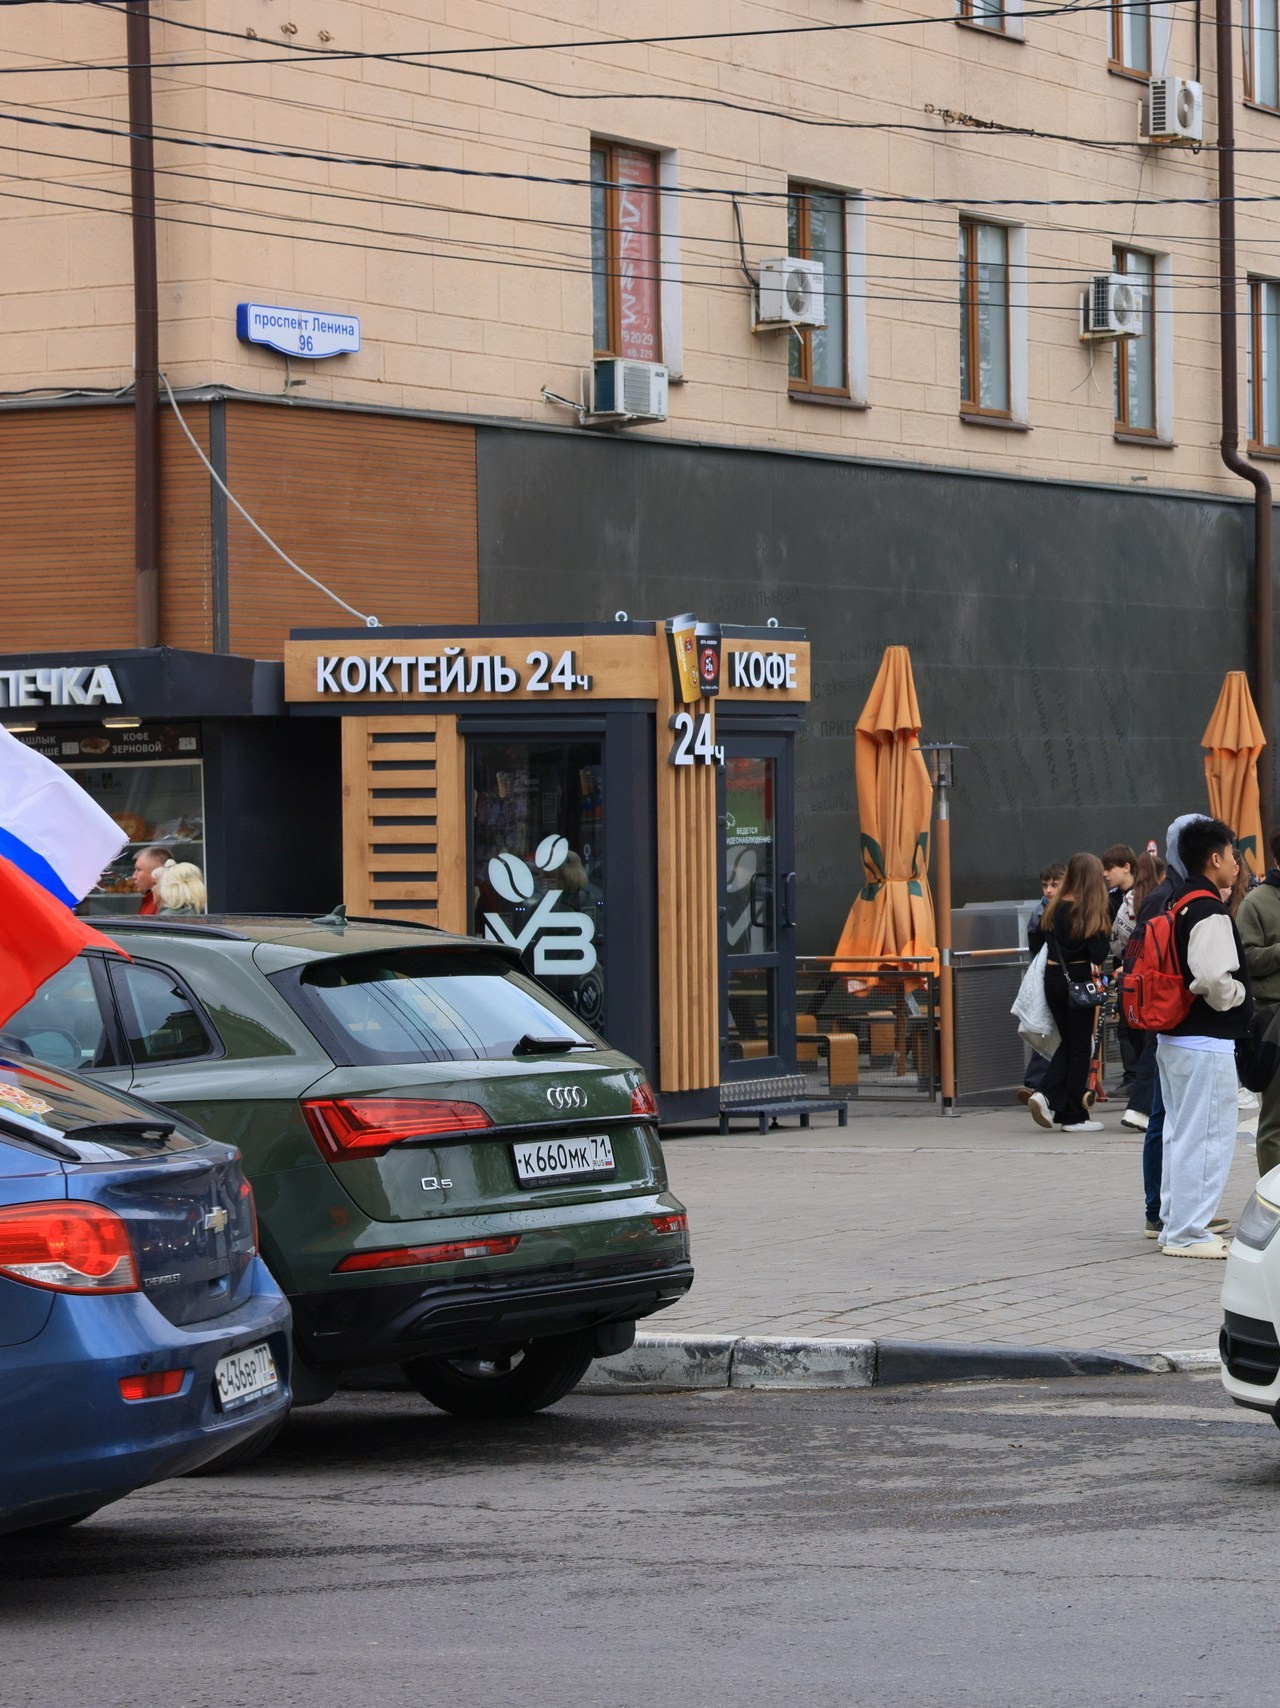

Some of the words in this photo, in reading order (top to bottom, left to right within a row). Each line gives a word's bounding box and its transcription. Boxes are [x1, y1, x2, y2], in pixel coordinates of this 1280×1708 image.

[254, 313, 309, 329] проспект
[312, 317, 355, 336] Ленина
[298, 335, 313, 351] 96
[316, 647, 518, 693] КОКТЕЙЛЬ
[525, 650, 592, 692] 24ч
[733, 651, 797, 689] КОФЕ
[123, 732, 149, 742] КОФЕ
[674, 712, 725, 765] 24ч
[112, 741, 162, 754] ЗЕРНОВОЙ
[736, 827, 758, 835] ВЕДЕТСЯ
[726, 835, 772, 845] ИДЕОНАБЛЮДЕНИЕ
[523, 1144, 590, 1174] К660МК
[591, 1138, 608, 1159] 71
[421, 1177, 453, 1191] Q5
[144, 1273, 181, 1287] CHEVROLET
[219, 1356, 258, 1396] С436ВР
